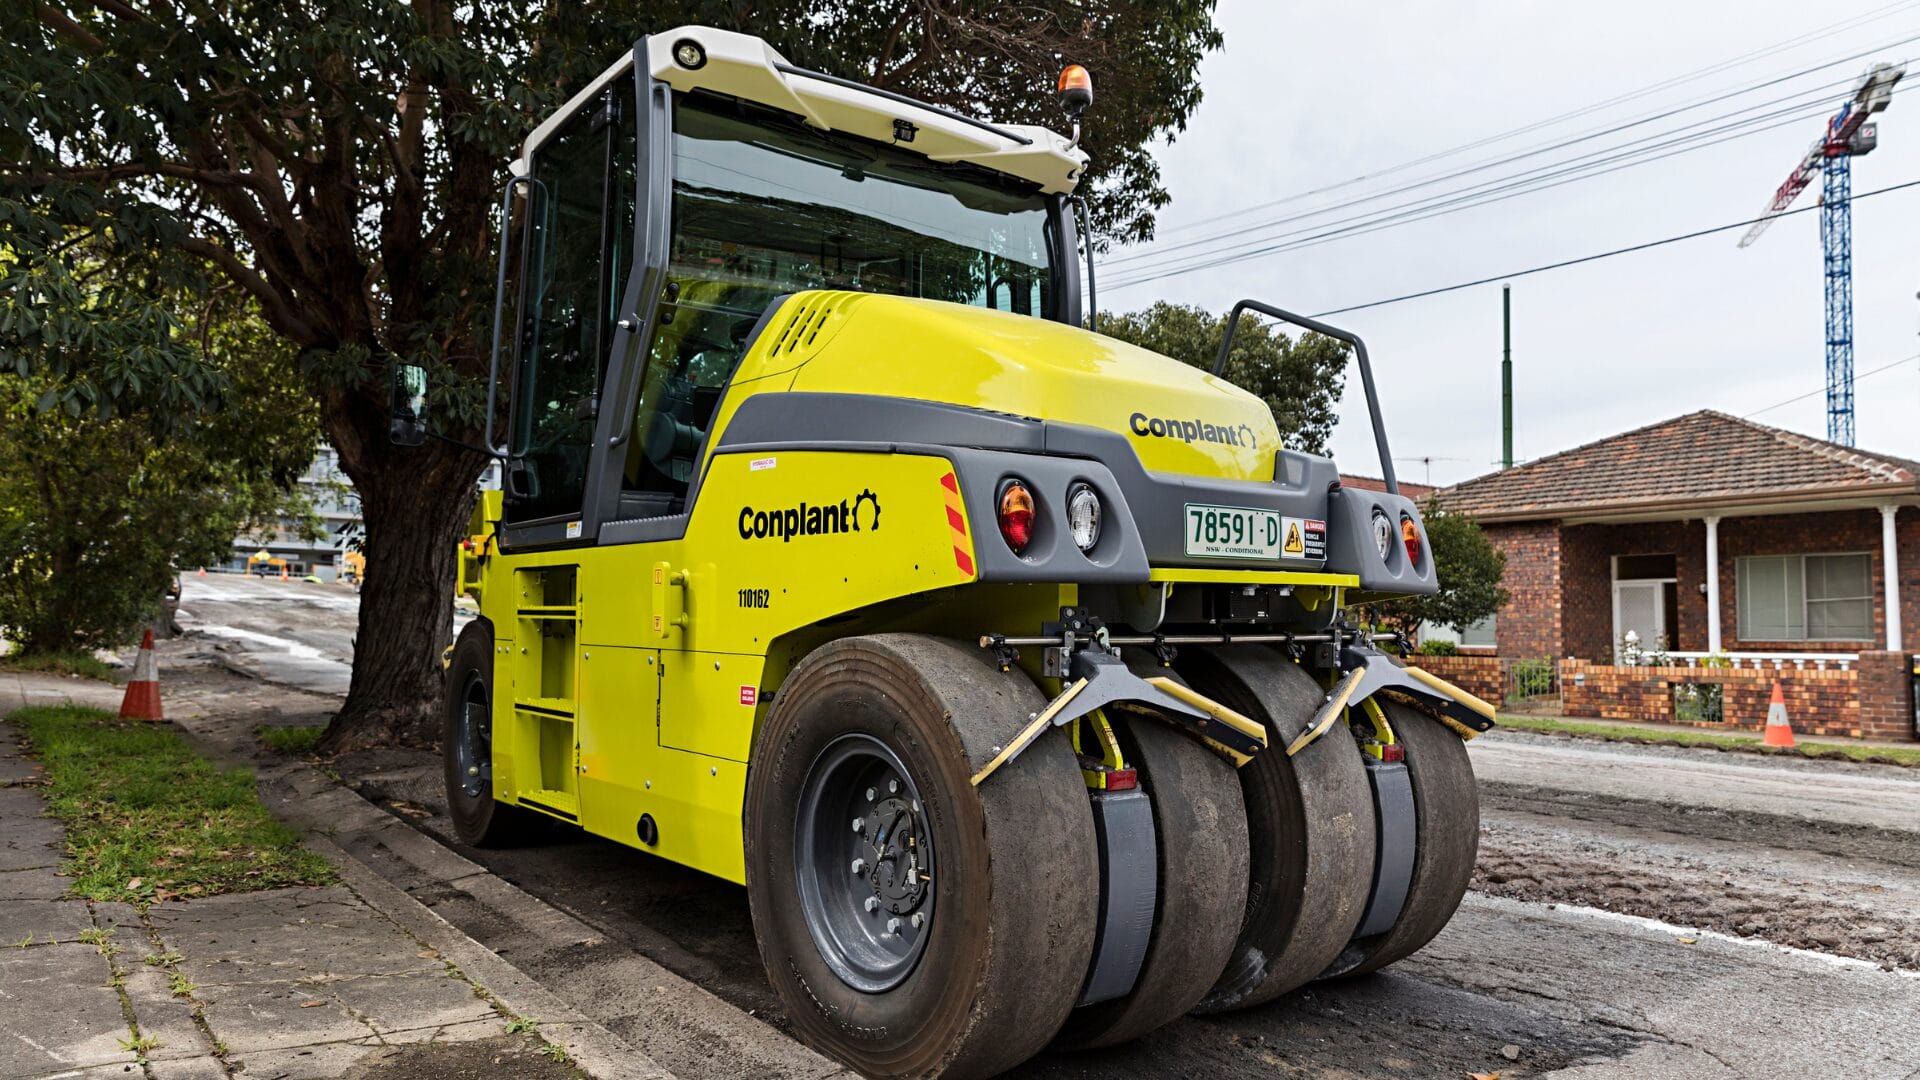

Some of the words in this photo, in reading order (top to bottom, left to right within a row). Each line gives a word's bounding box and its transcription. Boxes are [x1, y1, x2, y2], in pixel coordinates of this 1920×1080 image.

[1130, 413, 1238, 446] Conplant
[739, 499, 849, 542] Conplant
[1310, 522, 1324, 530] DANGER
[1225, 546, 1264, 555] CONDITIONAL
[738, 588, 769, 608] 110162
